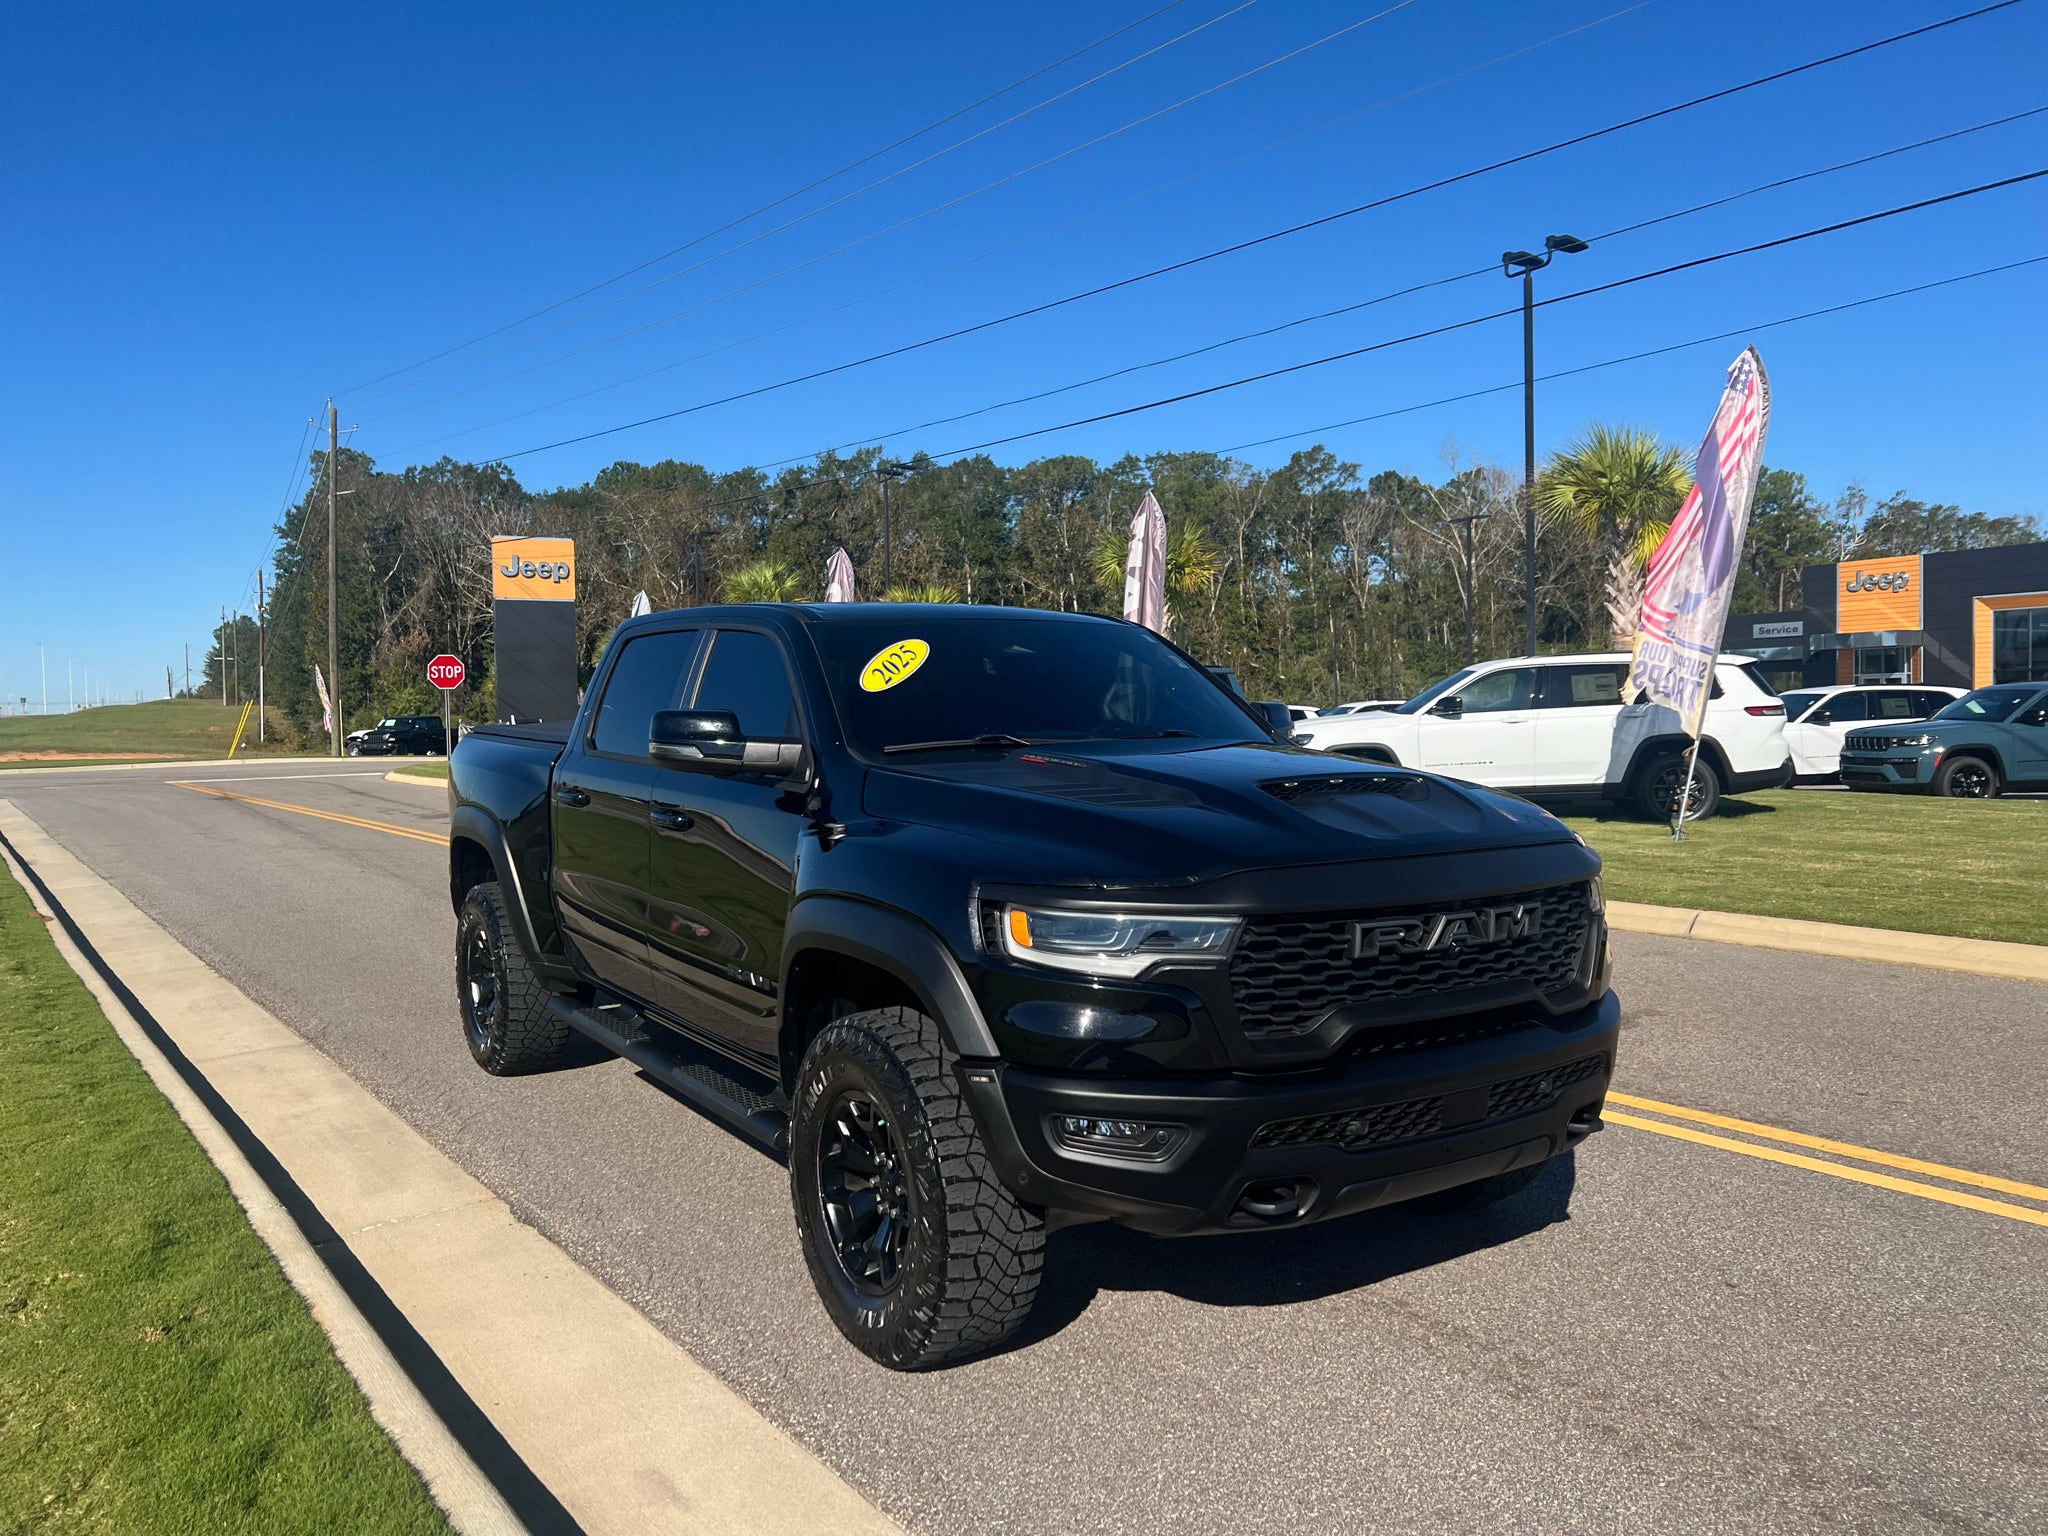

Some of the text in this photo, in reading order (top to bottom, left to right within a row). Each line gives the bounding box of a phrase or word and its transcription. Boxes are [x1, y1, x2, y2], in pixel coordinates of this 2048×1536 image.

[500, 555, 570, 583] Jeep
[1847, 570, 1909, 593] Jeep
[1758, 625, 1798, 635] Service
[430, 665, 462, 679] STOP
[871, 644, 917, 685] 2025
[1347, 901, 1542, 959] RAM
